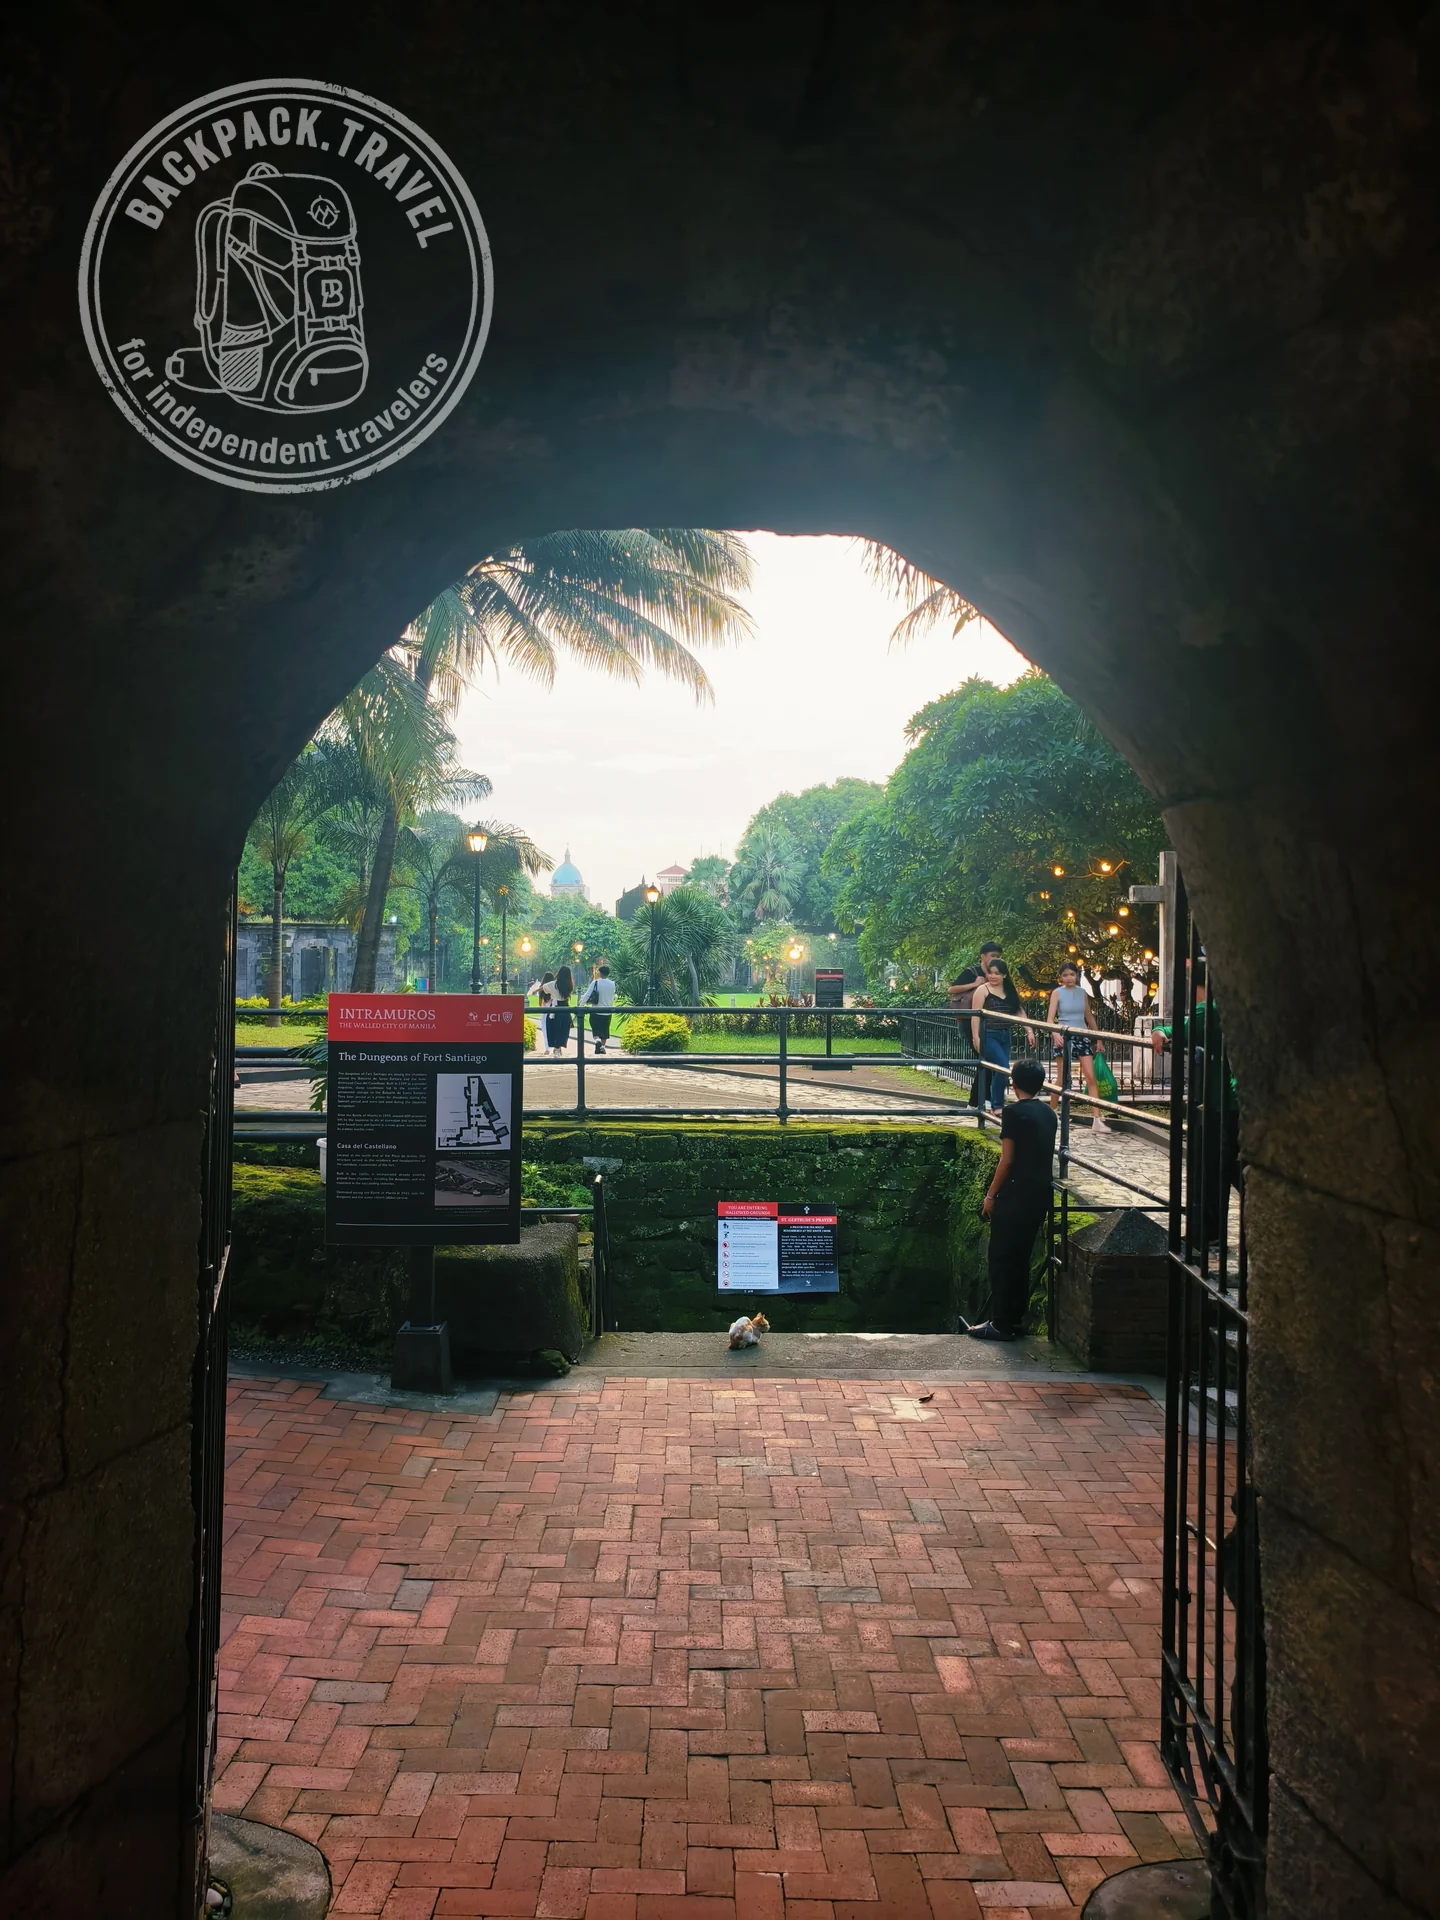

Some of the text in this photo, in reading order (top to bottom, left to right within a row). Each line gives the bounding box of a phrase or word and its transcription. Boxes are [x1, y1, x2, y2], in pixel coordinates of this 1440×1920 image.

[339, 1008, 436, 1021] INTRAMUROS
[483, 1013, 501, 1023] JCI
[338, 1052, 488, 1065] The Dungeons of Fort Santiago
